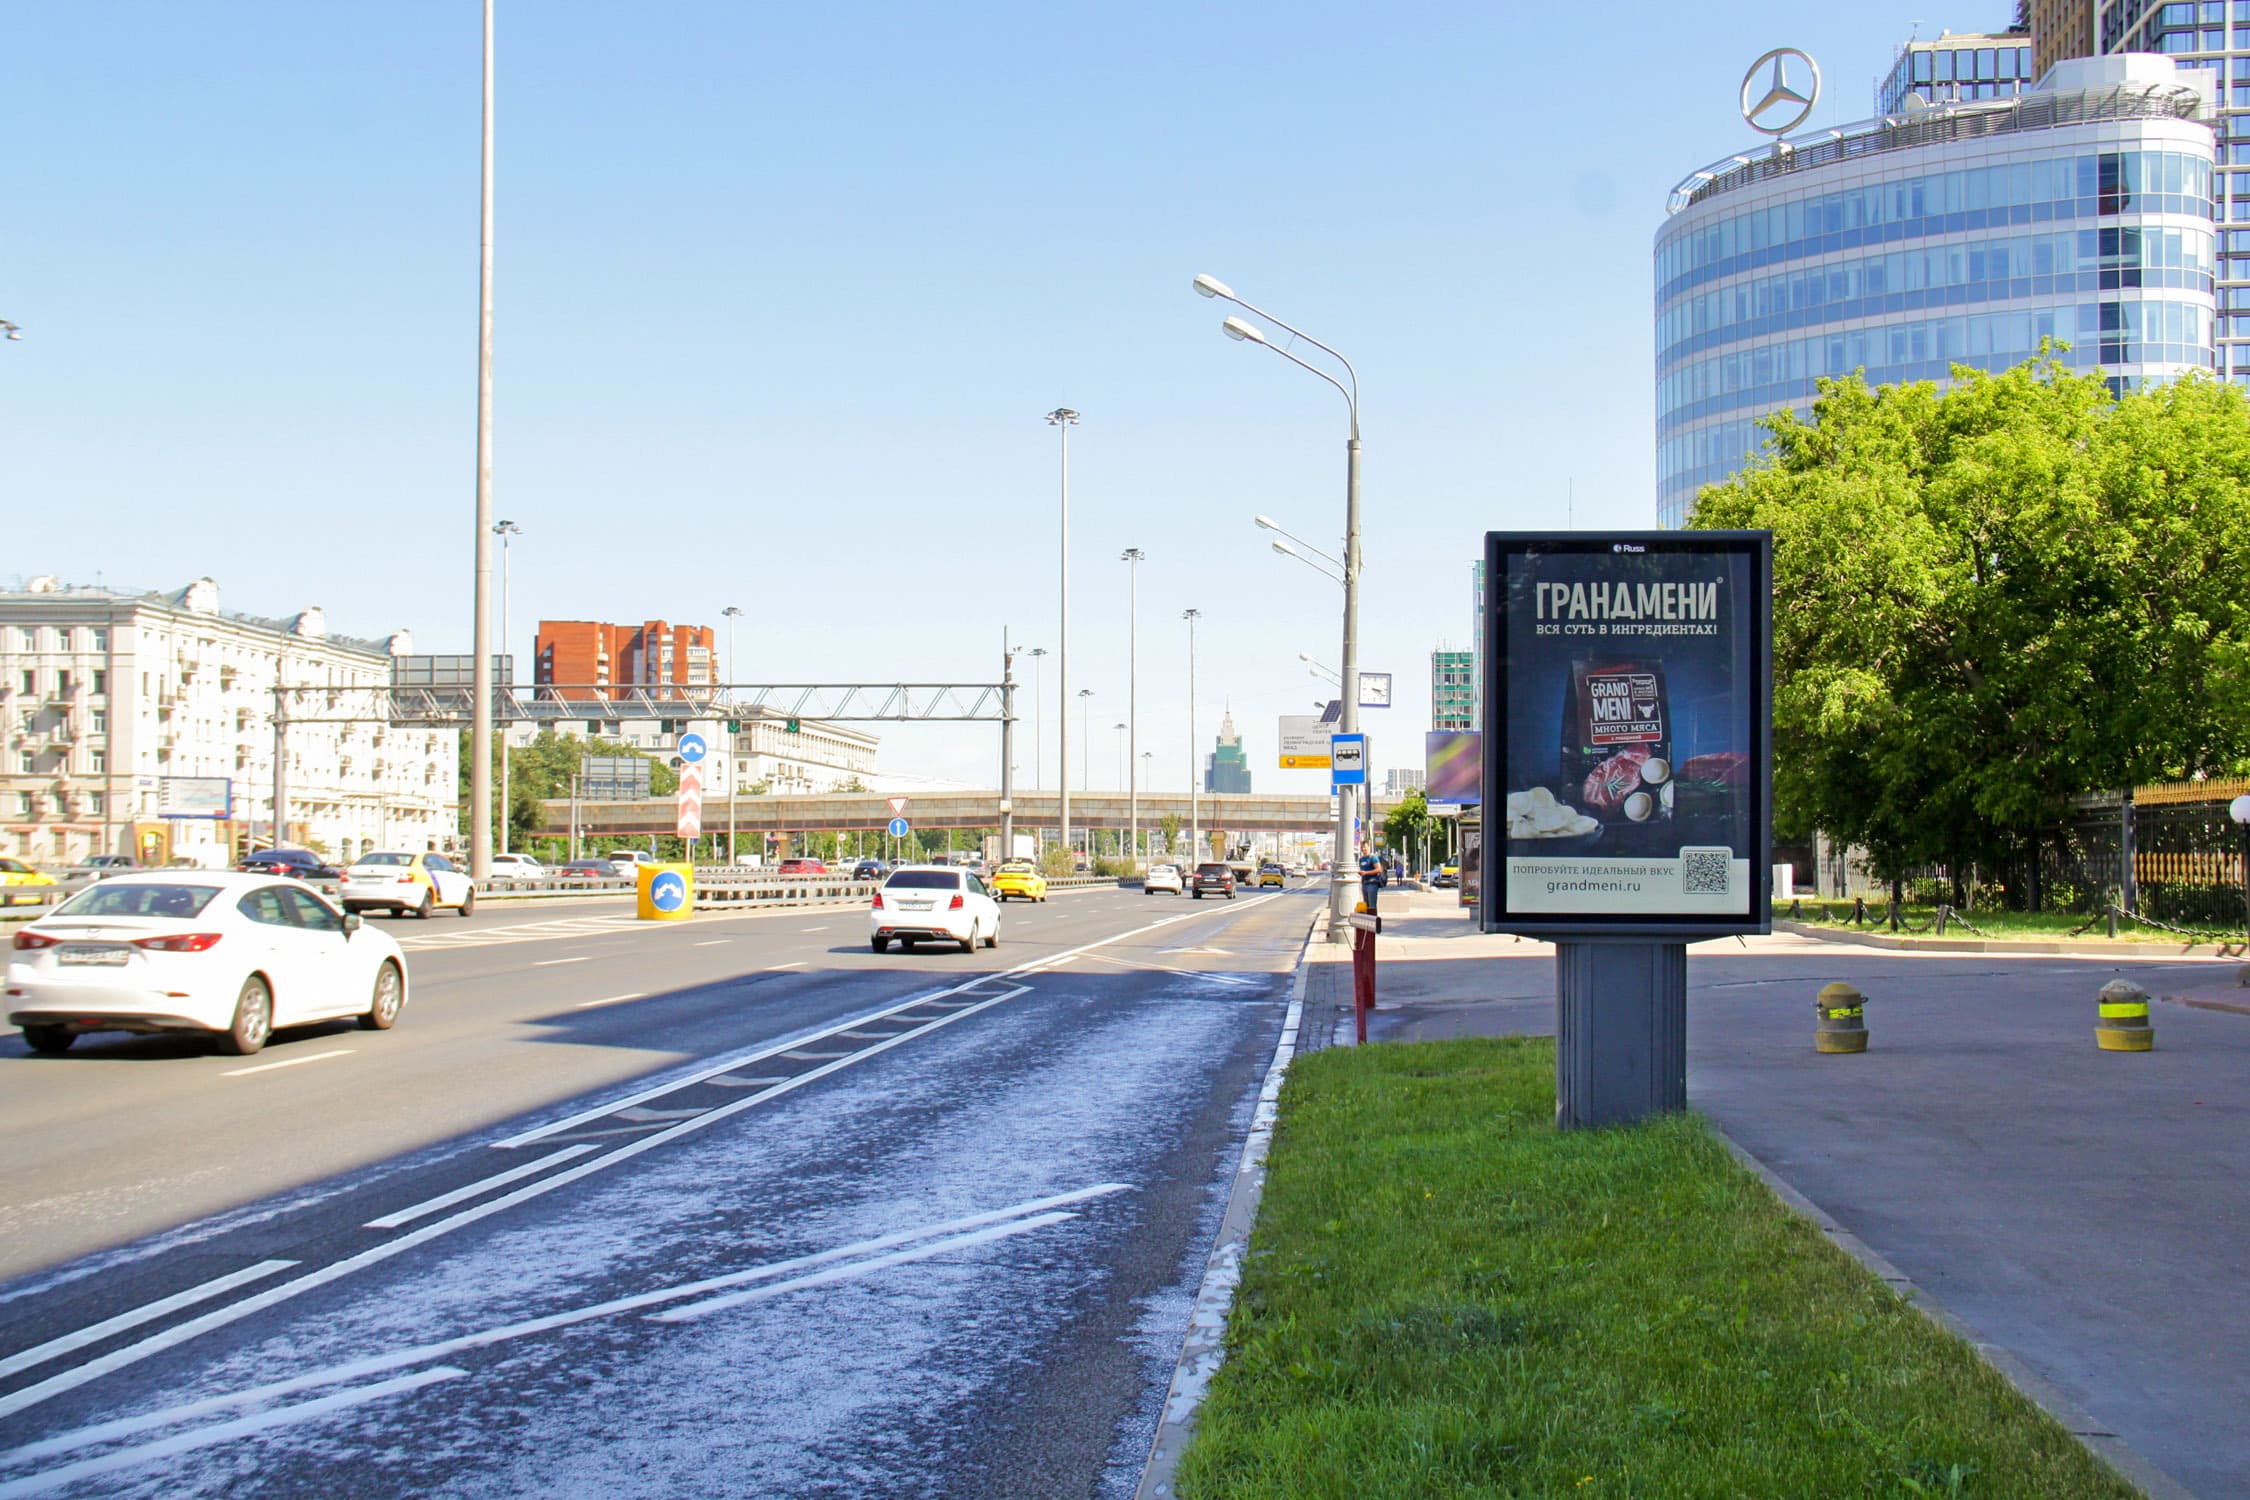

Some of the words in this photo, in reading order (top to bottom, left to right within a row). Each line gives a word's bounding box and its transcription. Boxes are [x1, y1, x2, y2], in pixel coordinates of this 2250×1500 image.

[1623, 544, 1646, 553] Russ
[1536, 582, 1717, 620] ГРАНДМЕНИ
[1536, 624, 1560, 635] ВСЯ
[1564, 624, 1596, 635] СУТЬ
[1599, 624, 1608, 635] В
[1611, 624, 1717, 637] ИНГРЕДИЕНТАХ!
[1590, 682, 1629, 697] GRAND
[1592, 697, 1632, 721] MENI
[1594, 725, 1628, 734] МНОГО
[1630, 723, 1658, 733] МЯСА
[1513, 864, 1579, 875] ПОПРОБУЙТЕ
[1582, 865, 1648, 876] ИДЕАЛЬНЫЙ
[1650, 867, 1675, 876] ВКУС
[1546, 880, 1641, 894] grandmeni.ru
